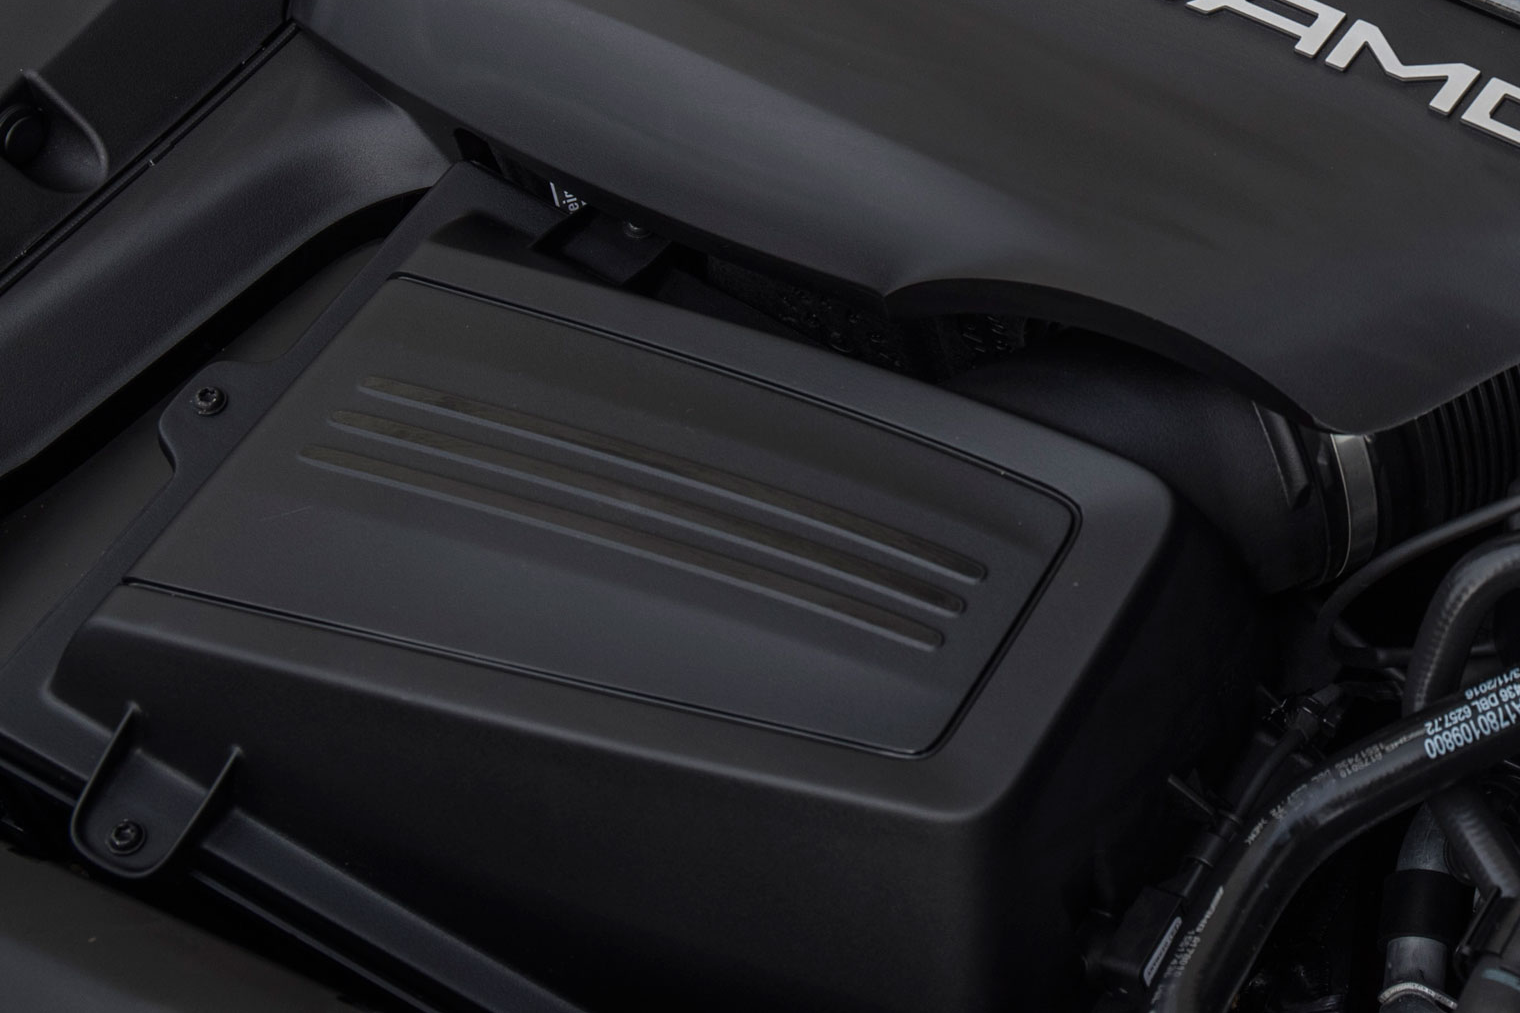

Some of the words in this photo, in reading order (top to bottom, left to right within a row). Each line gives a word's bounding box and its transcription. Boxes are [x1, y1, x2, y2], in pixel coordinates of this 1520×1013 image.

[1465, 671, 1520, 700] 3/11/2016
[1471, 697, 1499, 713] DBL
[1424, 707, 1472, 735] 6257.72
